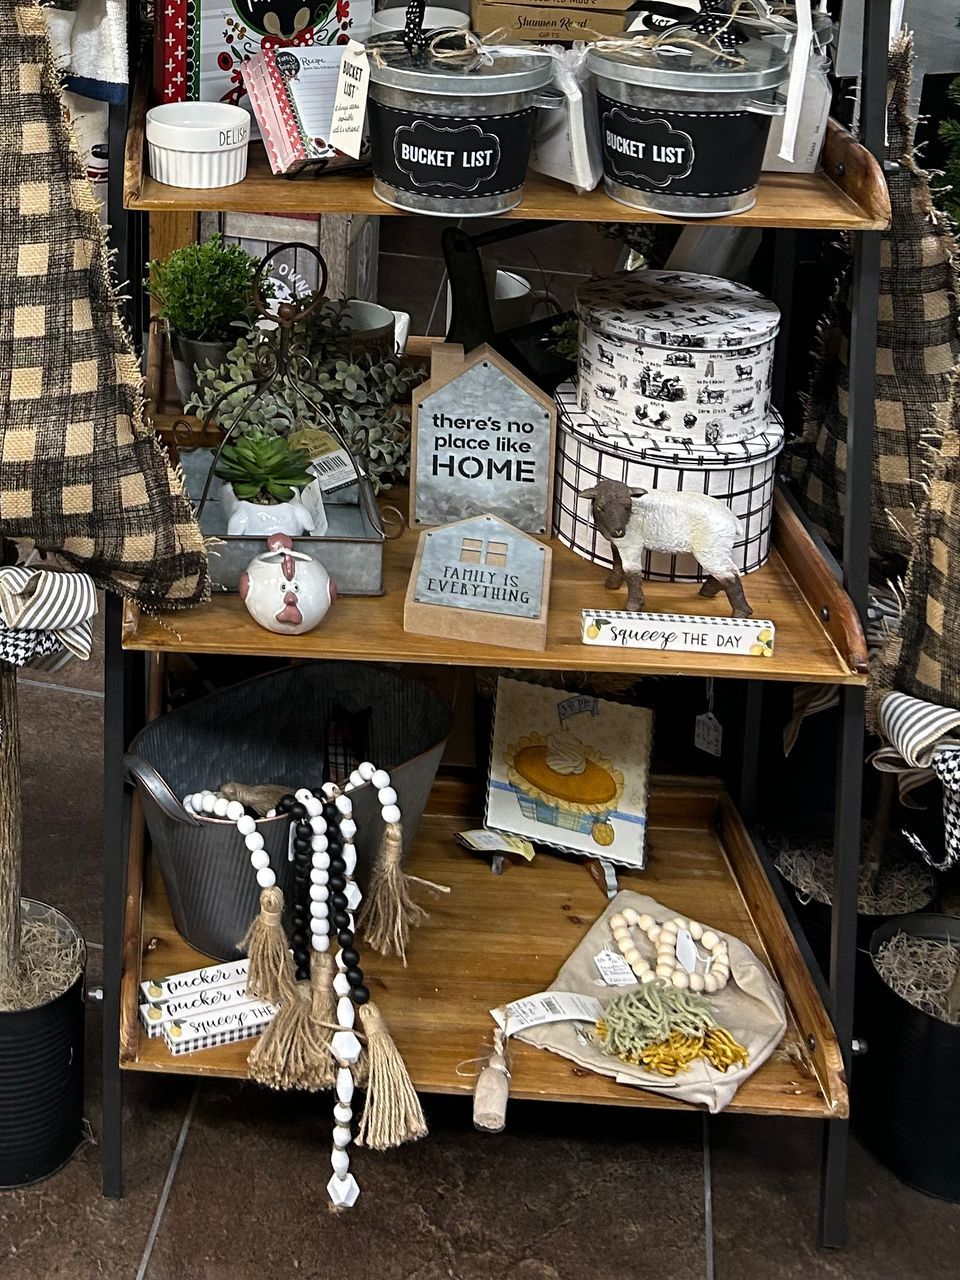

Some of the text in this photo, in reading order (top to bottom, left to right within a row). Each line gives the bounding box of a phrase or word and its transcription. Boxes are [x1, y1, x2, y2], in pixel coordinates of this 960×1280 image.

[512, 15, 557, 30] Shannon
[342, 60, 363, 82] BUCKET
[343, 81, 356, 98] LIST
[220, 125, 248, 147] DELISH
[605, 129, 685, 164] BUCKET LIST
[401, 142, 494, 168] BUCKET LIST
[433, 413, 534, 434] there's no
[434, 434, 532, 453] place like
[432, 454, 536, 483] HOME
[442, 565, 520, 588] FAMILY IS
[427, 578, 530, 605] EVERYTHING
[609, 625, 743, 650] squeeze THE DAY
[166, 969, 231, 995] pucker
[166, 989, 232, 1016] pucker
[190, 1005, 275, 1034] squeeze THE
